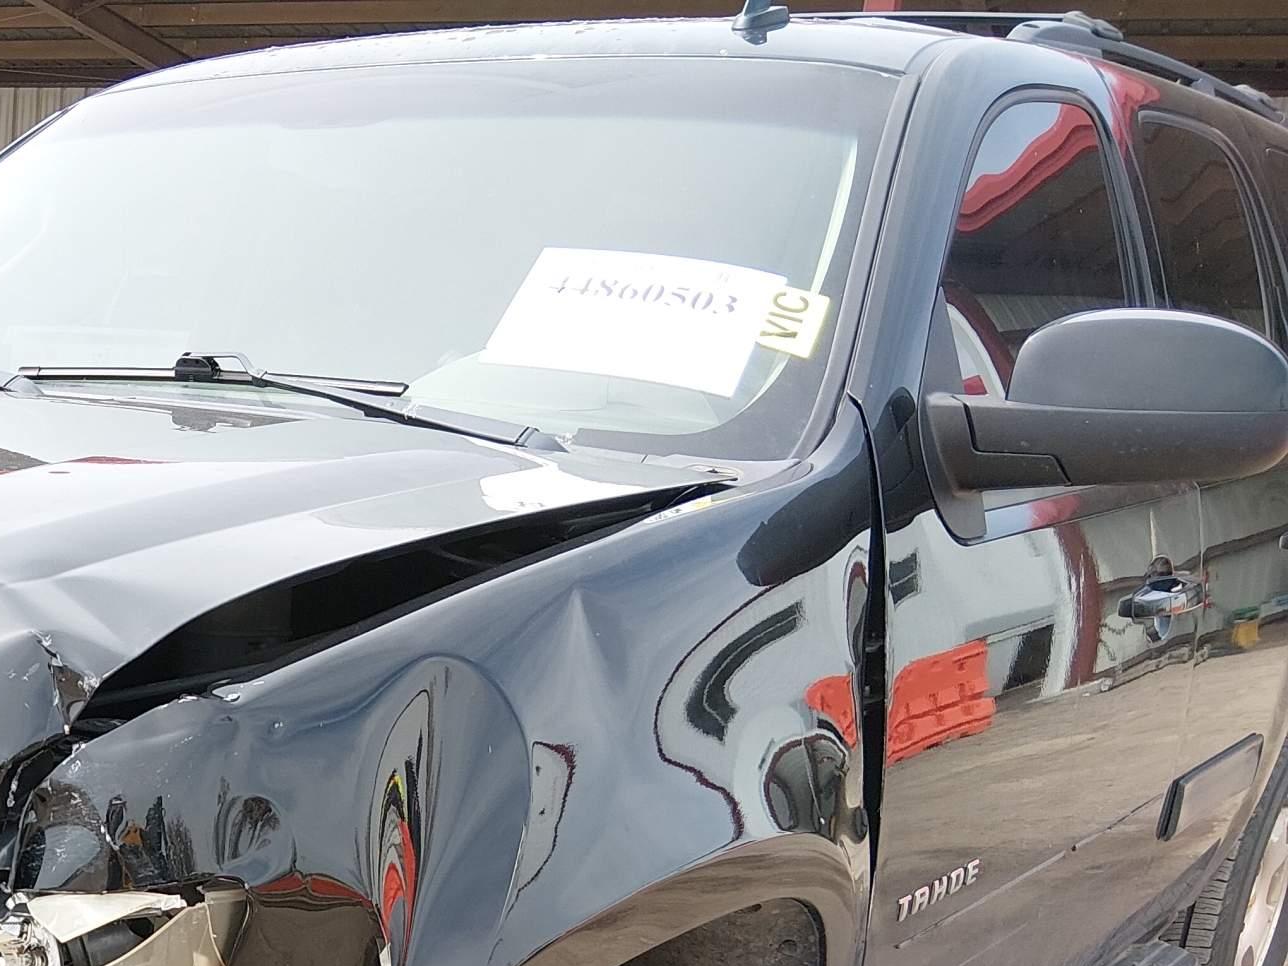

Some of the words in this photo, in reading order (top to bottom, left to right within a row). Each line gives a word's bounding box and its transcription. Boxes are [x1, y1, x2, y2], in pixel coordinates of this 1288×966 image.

[547, 275, 739, 314] 44860503
[760, 291, 809, 339] VIC
[896, 857, 981, 922] TAHOE
